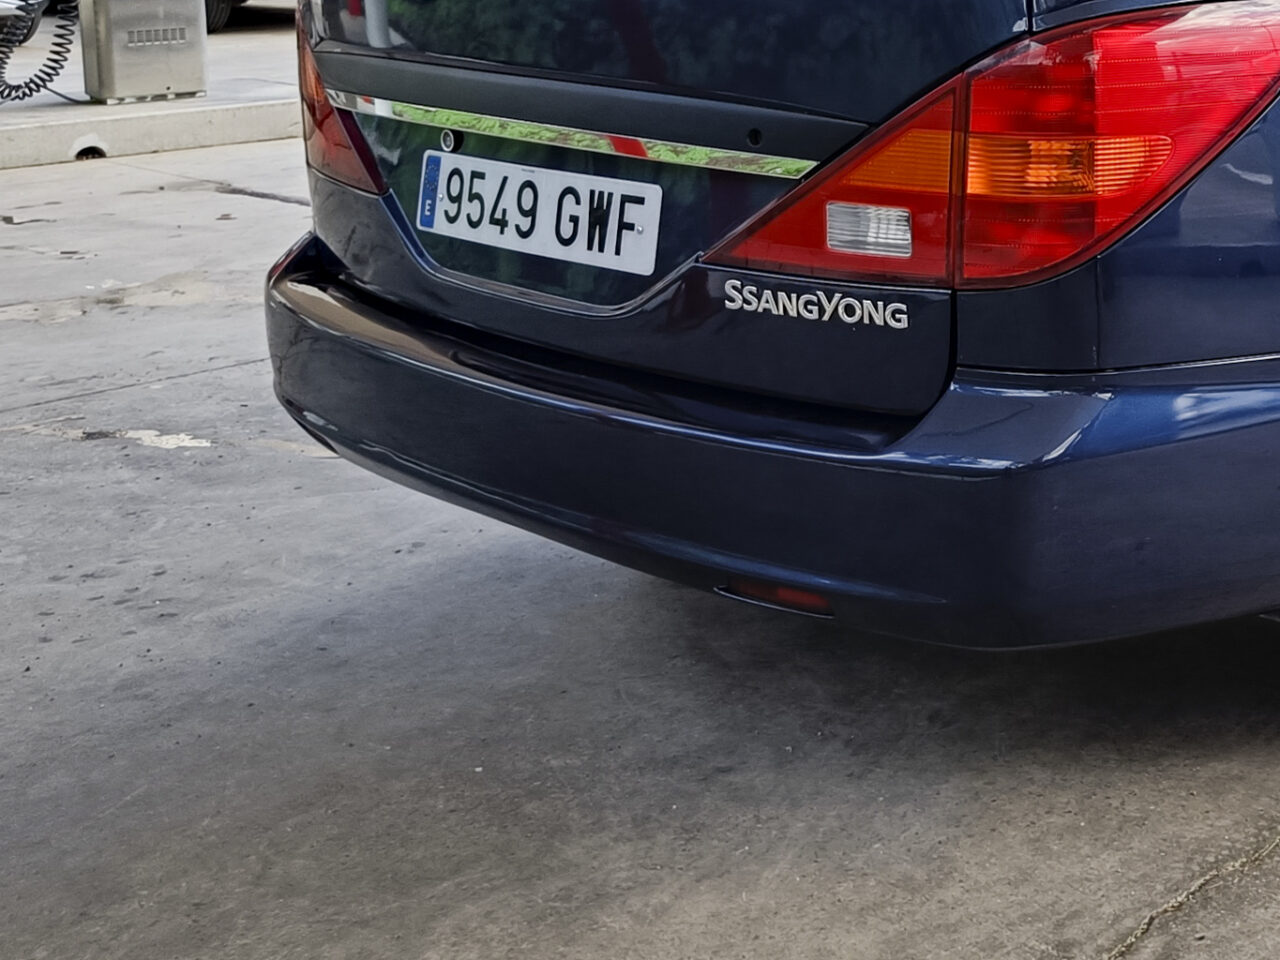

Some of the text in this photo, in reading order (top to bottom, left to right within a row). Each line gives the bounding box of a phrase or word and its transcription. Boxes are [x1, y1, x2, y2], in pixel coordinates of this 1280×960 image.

[424, 199, 432, 216] E
[443, 167, 646, 256] 9549 GWF
